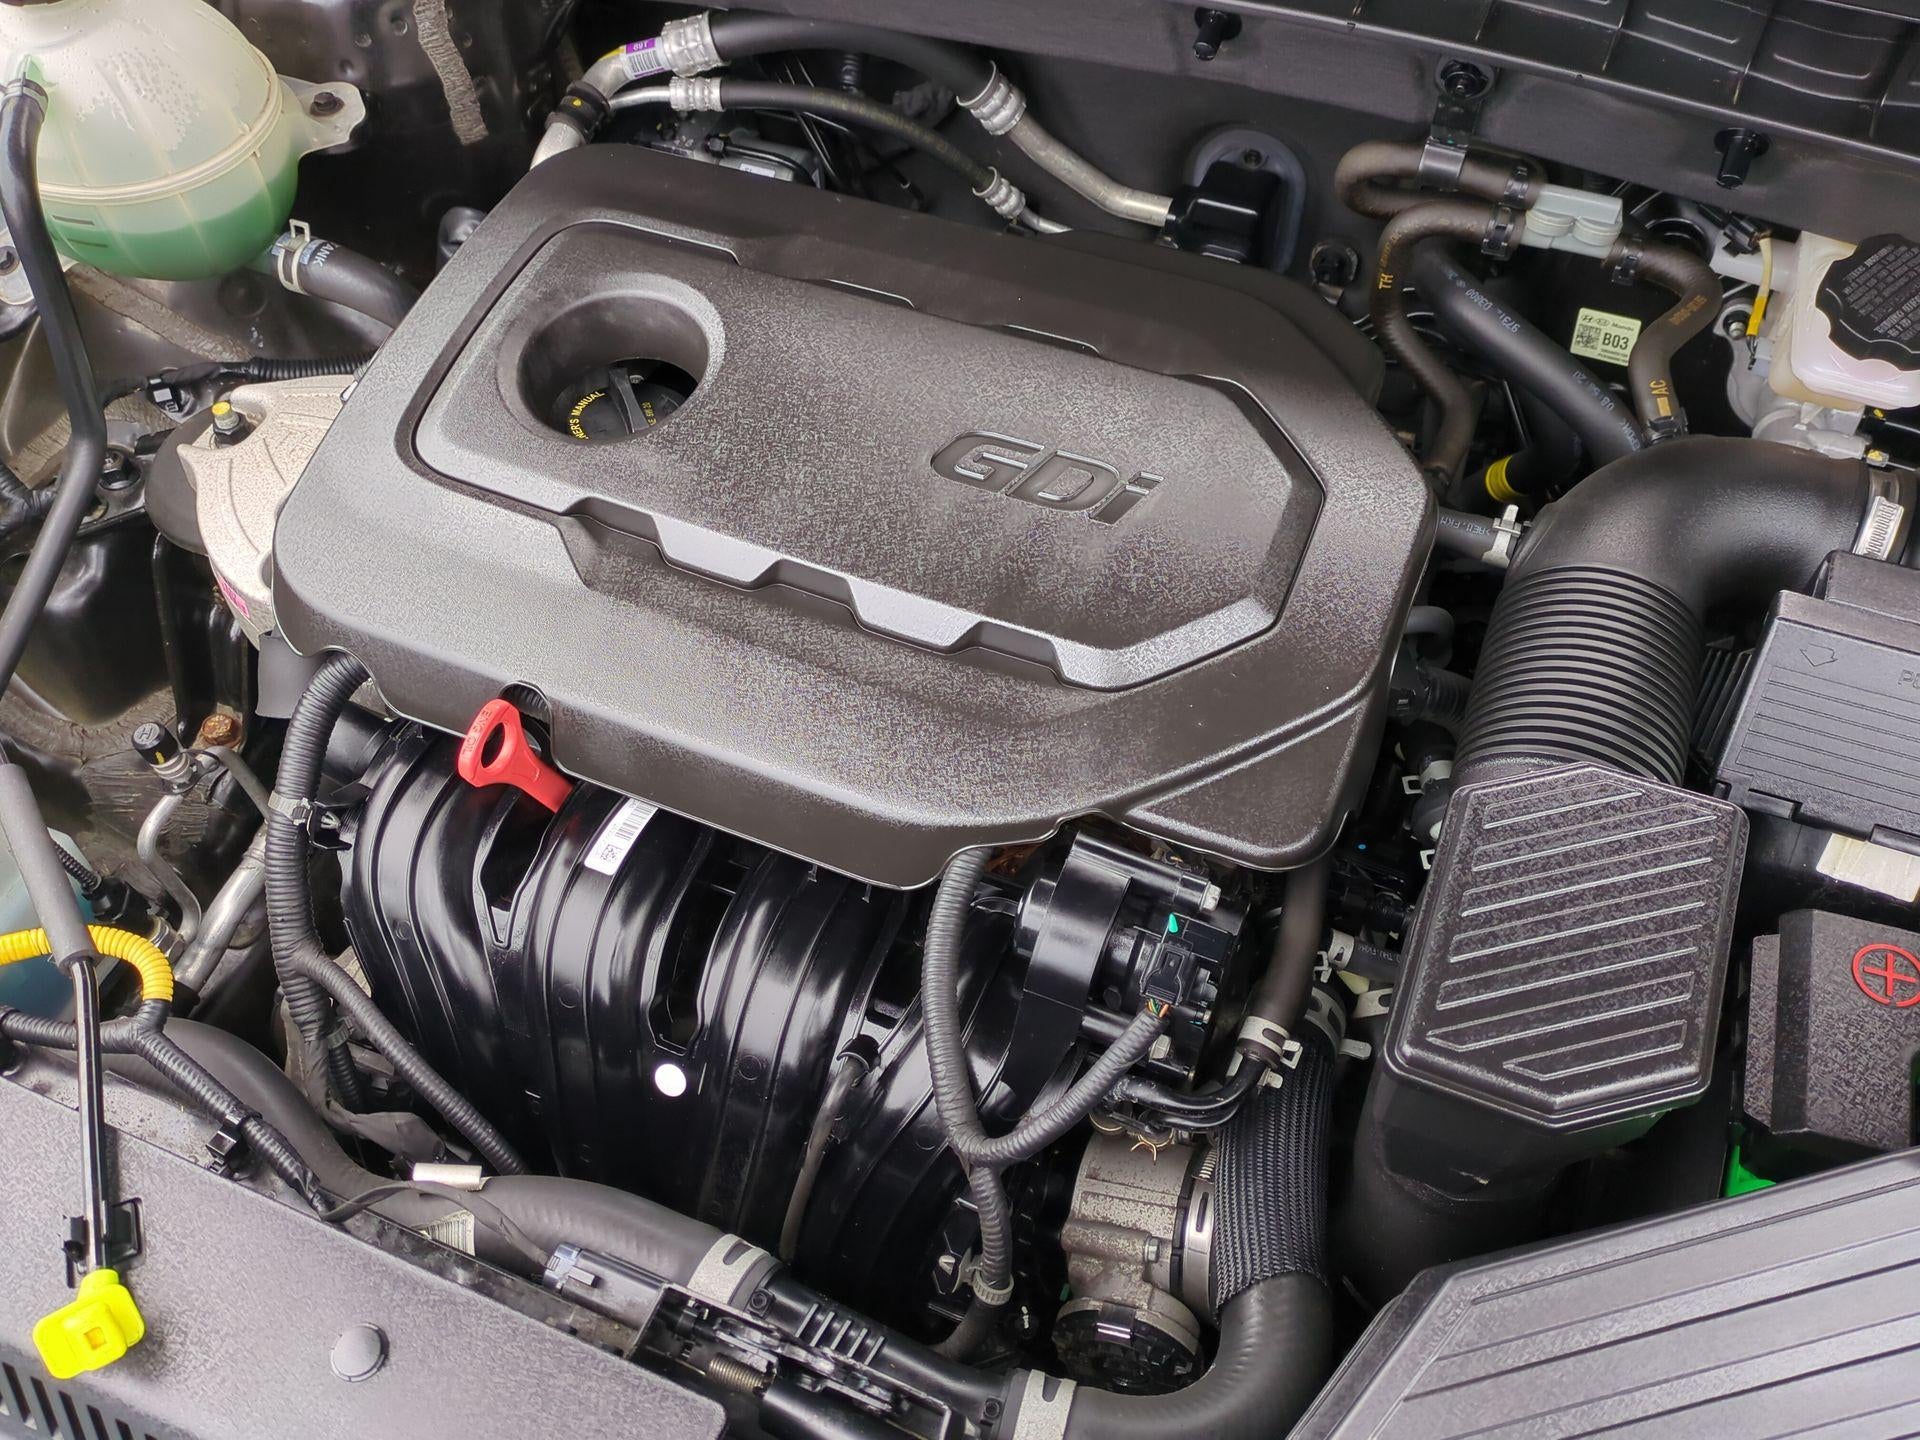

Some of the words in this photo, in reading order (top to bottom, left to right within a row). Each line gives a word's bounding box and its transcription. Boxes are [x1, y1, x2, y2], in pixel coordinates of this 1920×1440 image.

[1379, 272, 1394, 289] TH
[1602, 332, 1629, 350] B03
[1649, 379, 1670, 396] AC
[570, 390, 605, 417] MANUAL
[570, 417, 589, 440] NER'S
[930, 430, 1165, 526] GDi
